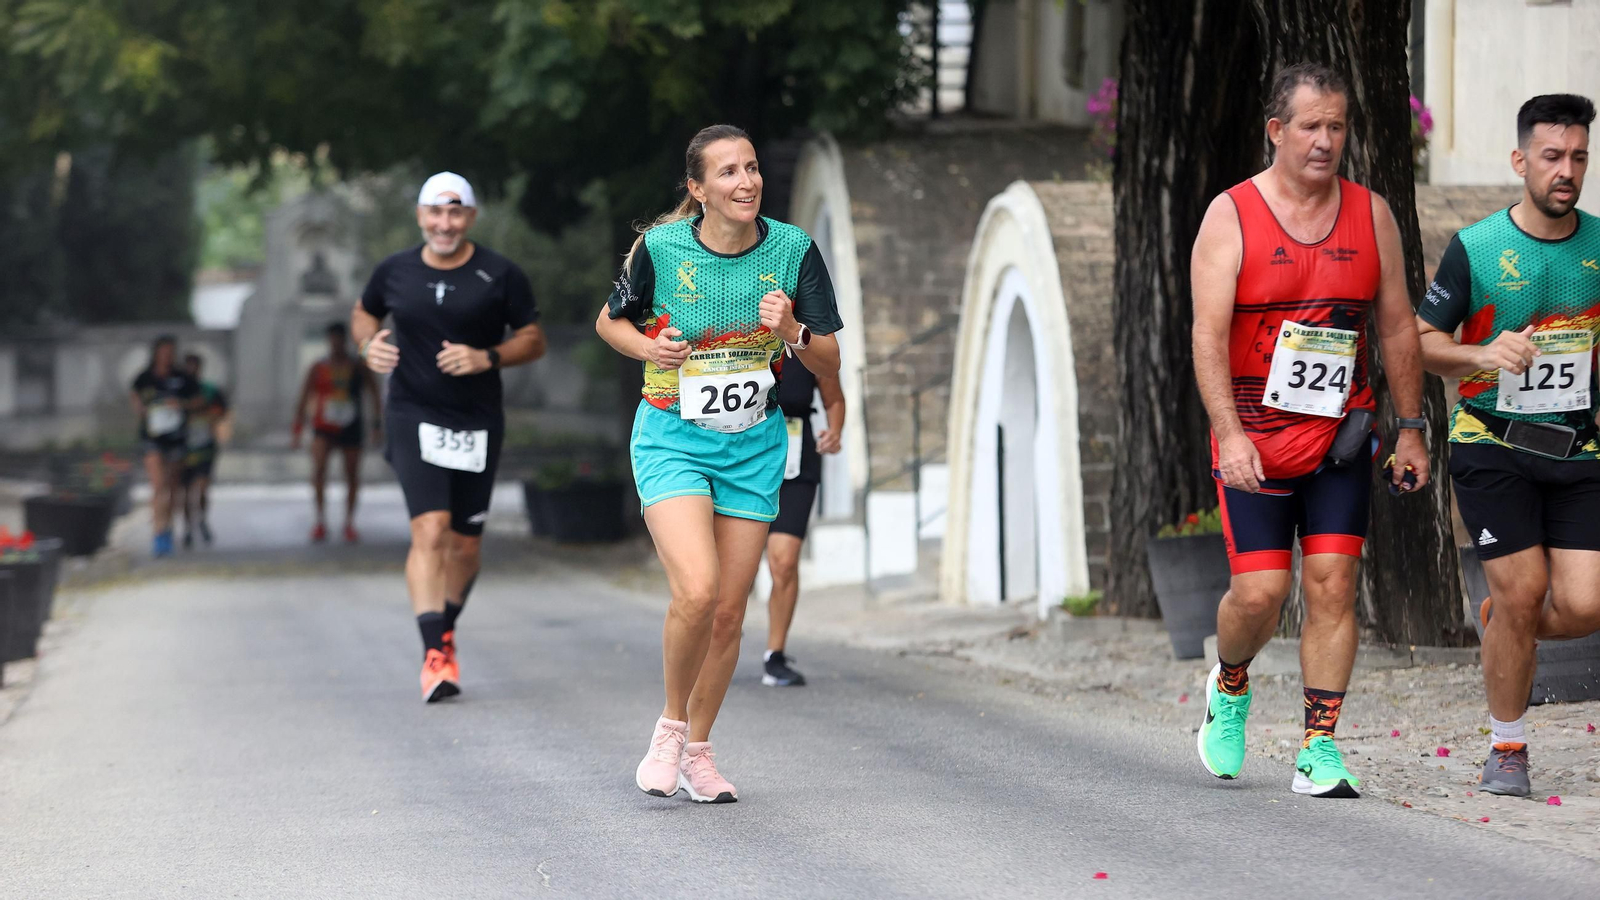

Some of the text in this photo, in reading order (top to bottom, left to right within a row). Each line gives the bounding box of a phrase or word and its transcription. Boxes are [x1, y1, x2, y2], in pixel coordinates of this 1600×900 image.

[1293, 327, 1323, 338] CARRERA
[689, 352, 727, 361] CARRERA
[728, 350, 767, 358] SOLIDARIA
[1288, 360, 1346, 394] 324
[1518, 362, 1575, 392] 125
[701, 380, 760, 415] 262
[434, 426, 475, 453] 359
